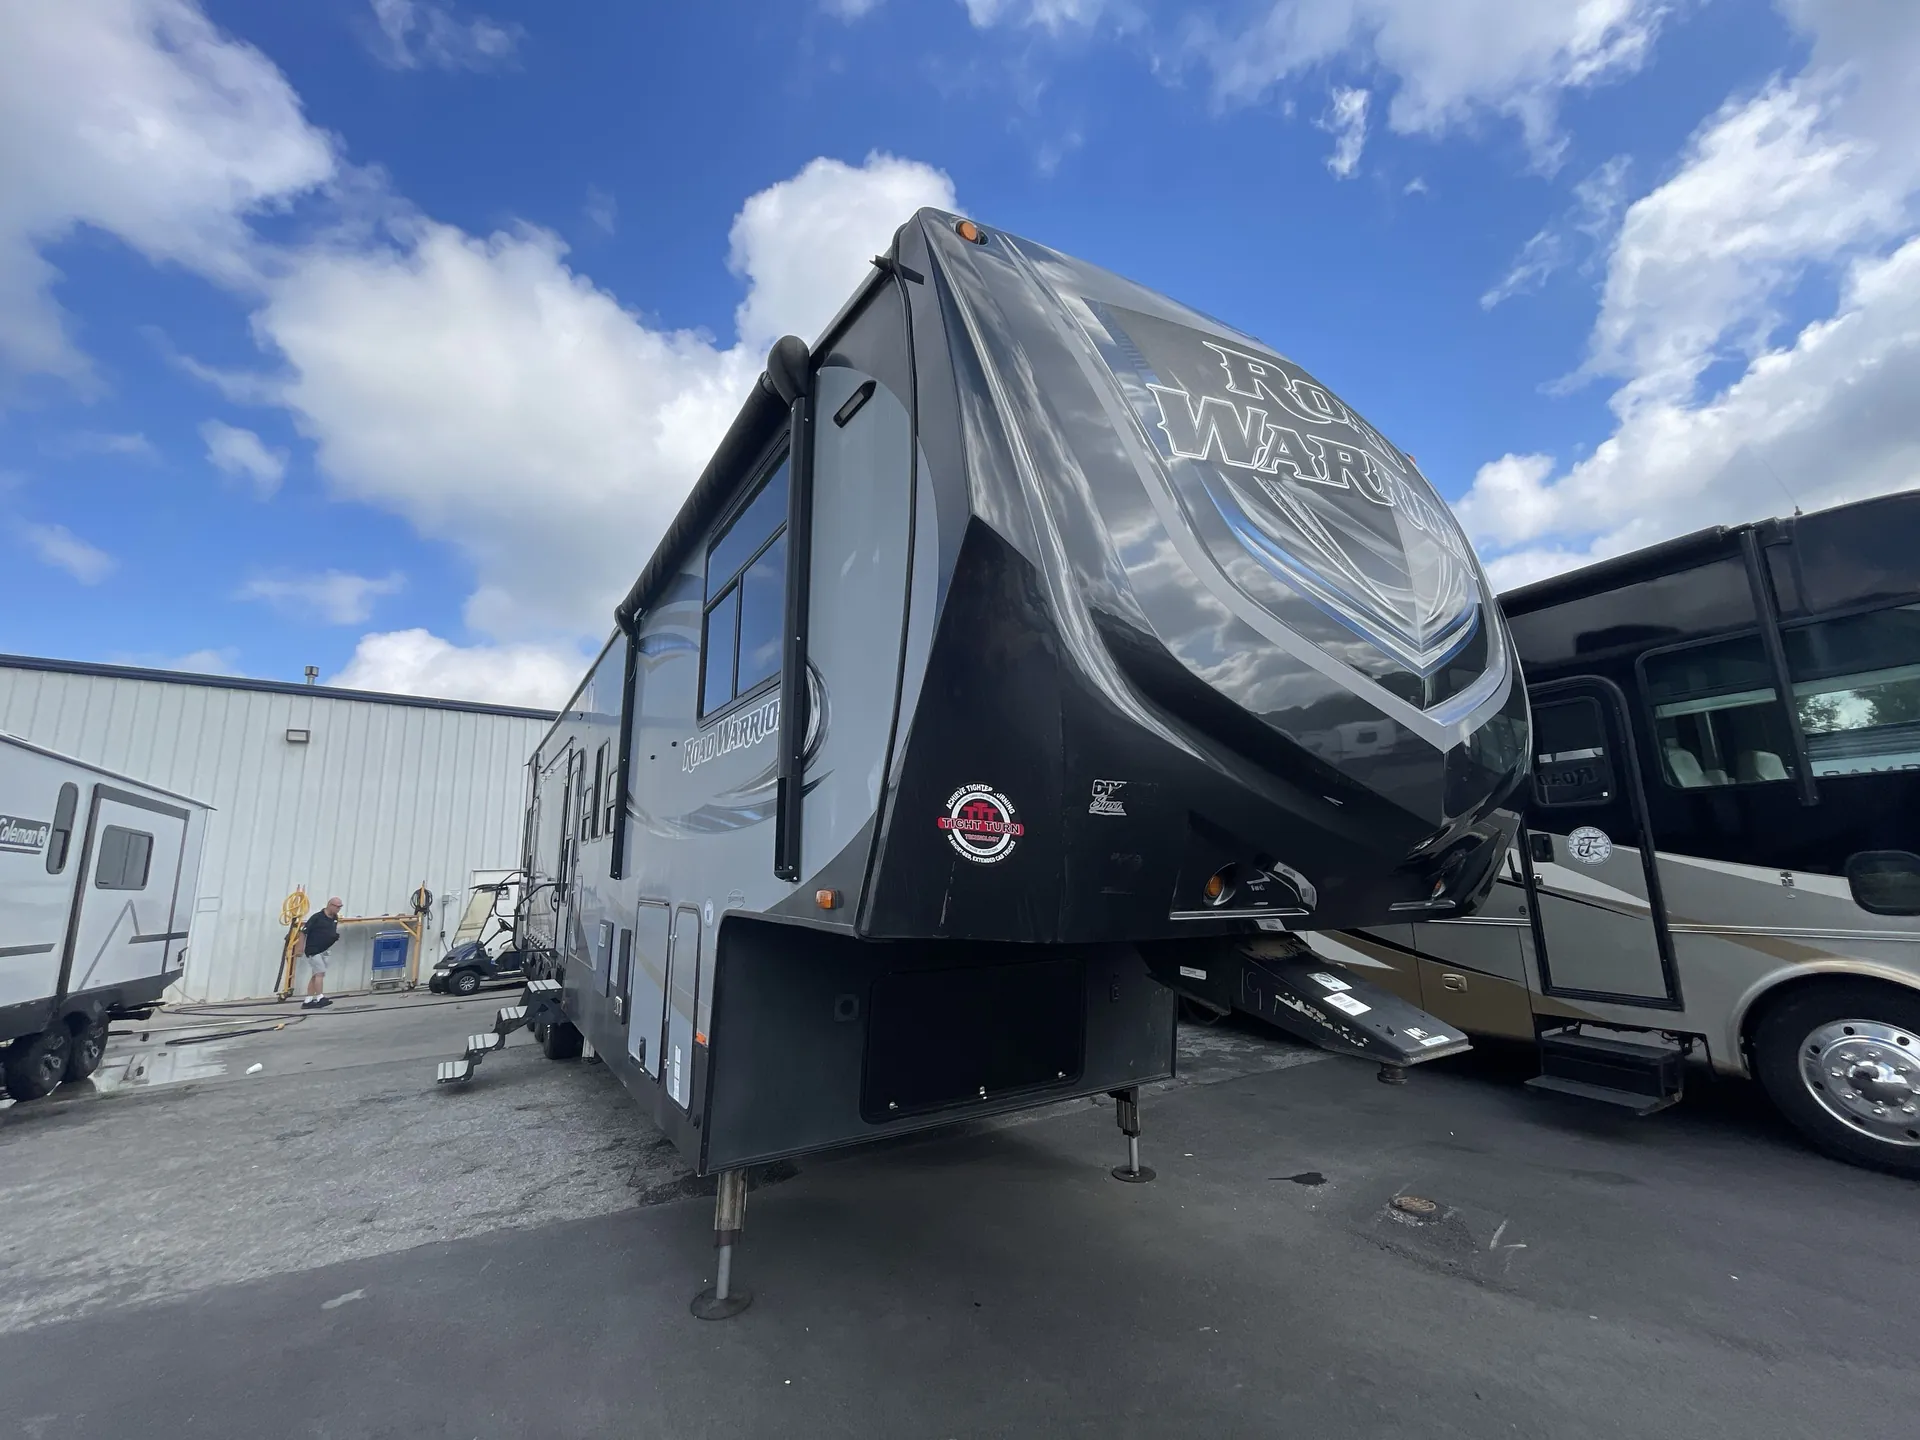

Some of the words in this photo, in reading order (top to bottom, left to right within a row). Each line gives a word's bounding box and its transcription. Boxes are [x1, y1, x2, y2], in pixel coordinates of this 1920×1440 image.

[1202, 340, 1407, 474] RO
[682, 737, 716, 774] ROAD
[716, 698, 780, 755] WARRIO
[946, 787, 967, 810] ACHIEVE
[994, 792, 1016, 815] URNING
[1090, 796, 1124, 812] Super
[942, 818, 982, 831] TIGHT
[985, 820, 1020, 834] TURN
